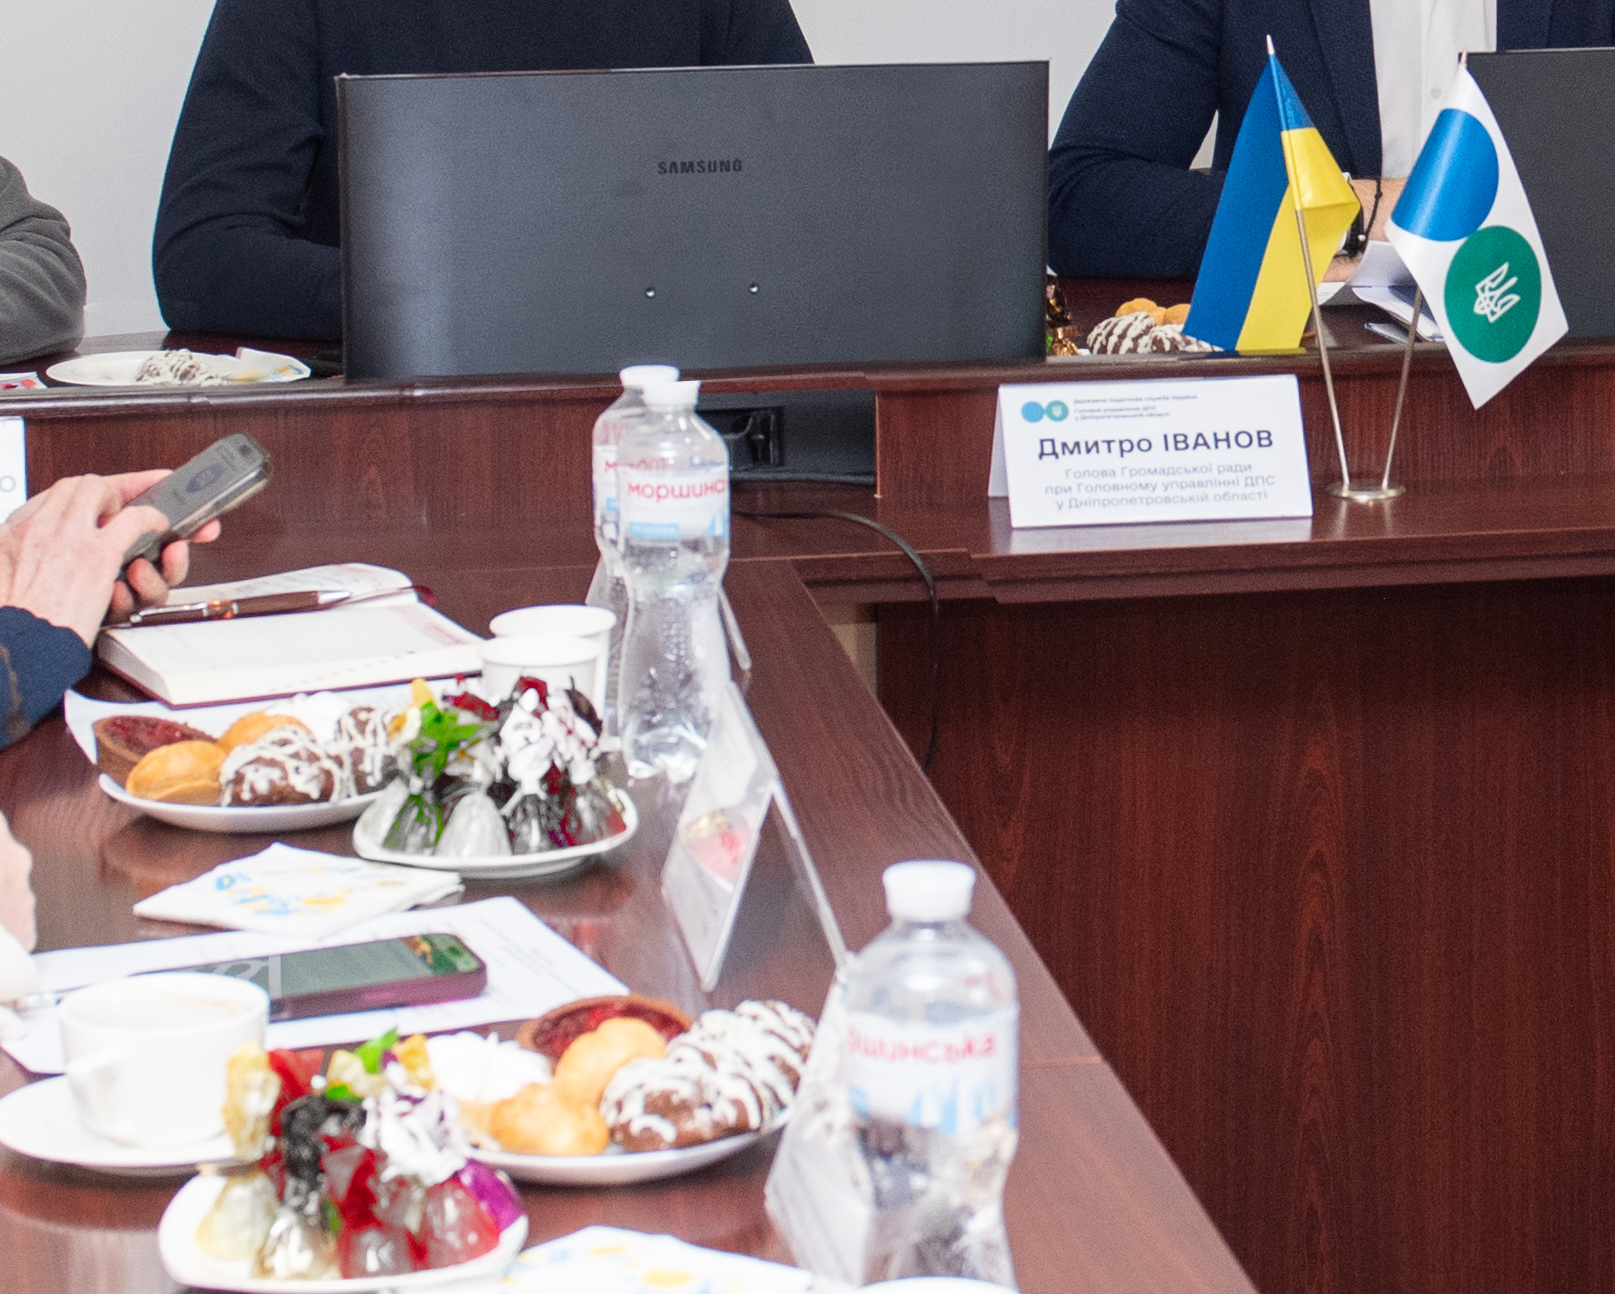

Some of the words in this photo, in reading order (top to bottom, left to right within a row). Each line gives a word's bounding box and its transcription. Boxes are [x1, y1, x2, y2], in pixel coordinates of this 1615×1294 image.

[657, 159, 743, 175] SAMSUNG
[1038, 436, 1152, 461] Дмитро
[1163, 429, 1274, 452] ІВАНОВ
[1065, 467, 1116, 480] Голова
[1121, 463, 1212, 478] Громадської
[1217, 462, 1252, 476] ради
[1045, 483, 1072, 496] при
[1076, 480, 1158, 494] Головному
[1161, 476, 1239, 493] управлінні
[1244, 475, 1276, 488] ДПС
[1068, 493, 1210, 510] Дніпропетровській
[1213, 490, 1268, 504] області
